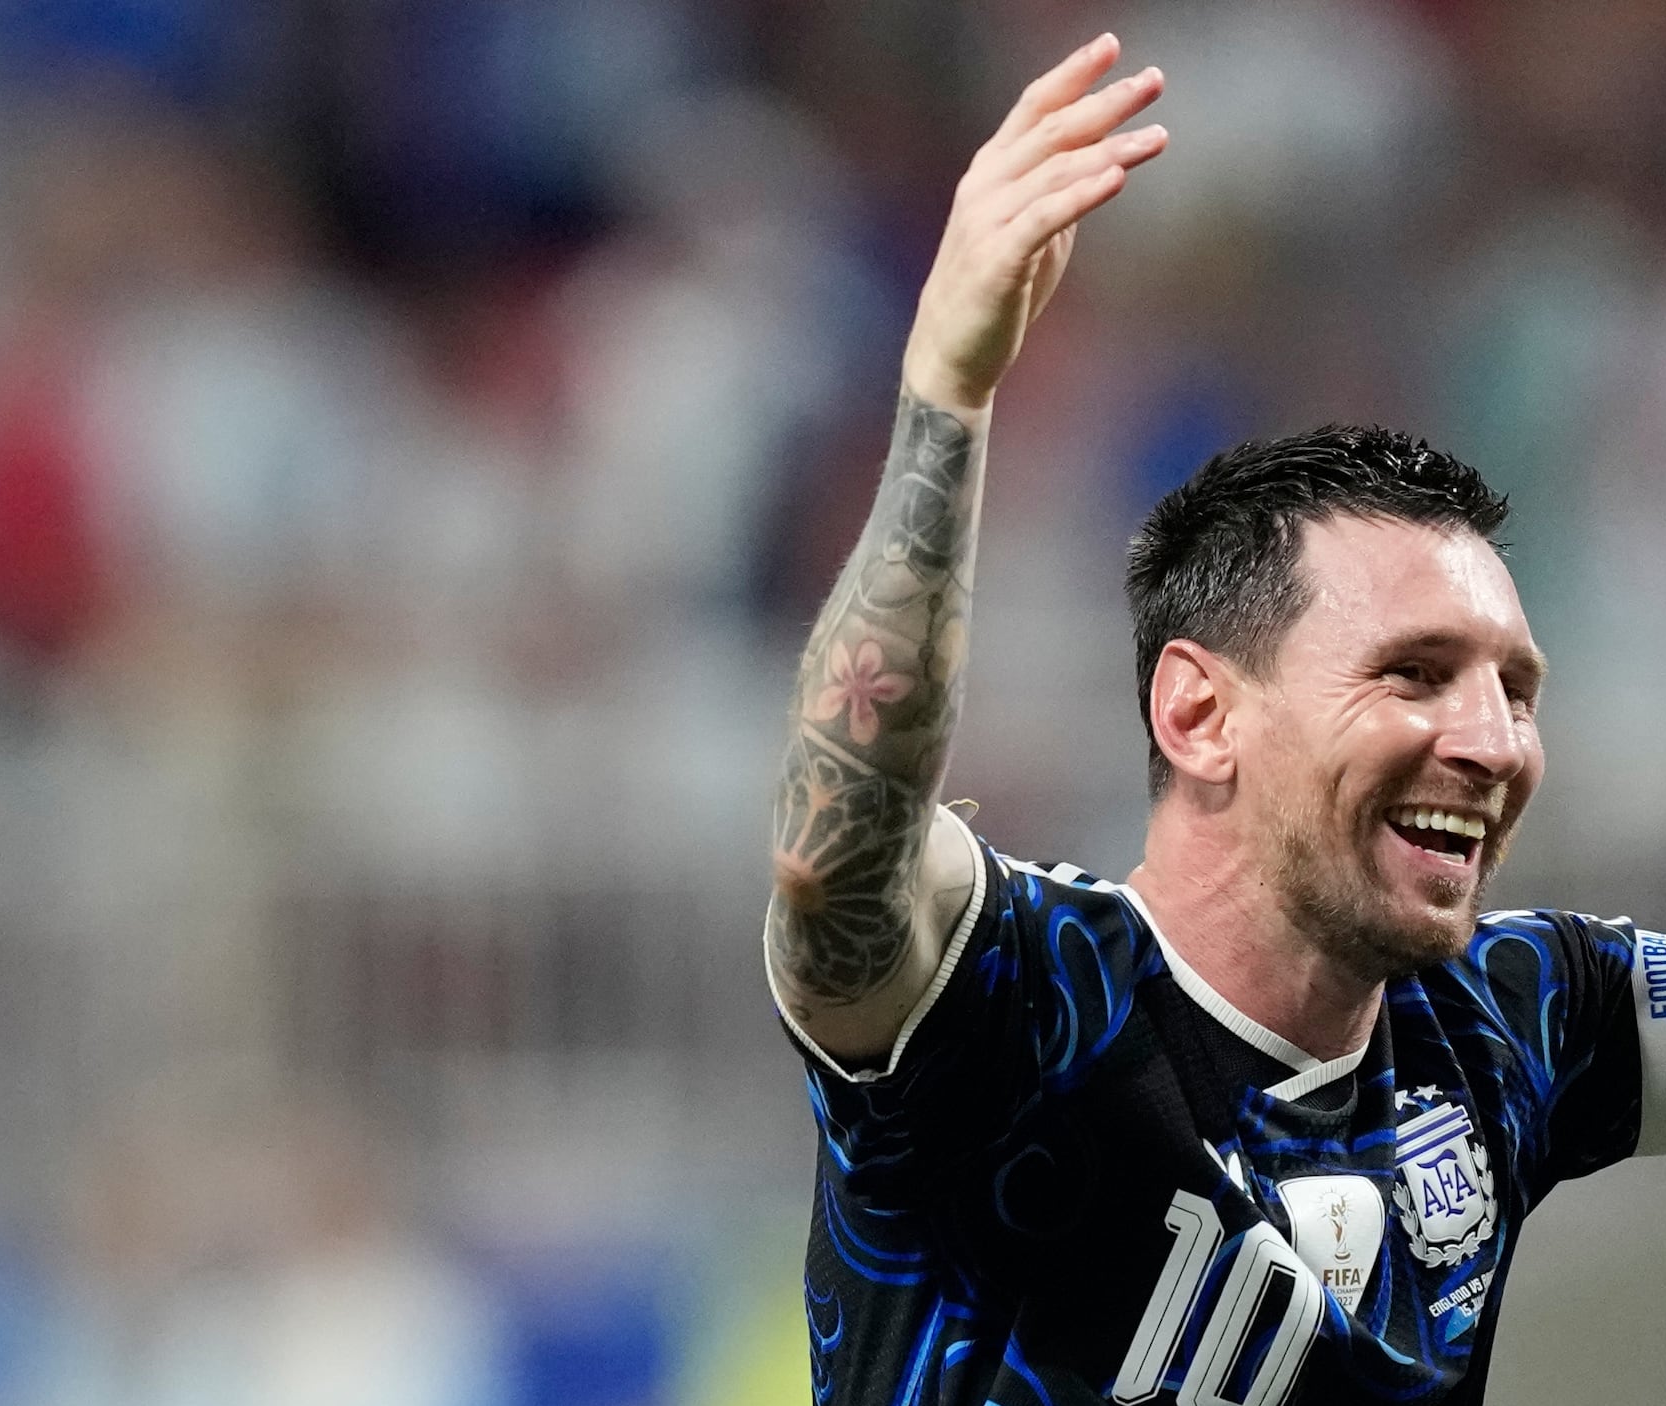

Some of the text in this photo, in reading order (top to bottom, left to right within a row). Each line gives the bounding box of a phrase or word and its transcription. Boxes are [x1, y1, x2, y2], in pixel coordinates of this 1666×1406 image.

[1417, 1148, 1477, 1218] AFA
[1323, 1268, 1361, 1287] FIFA
[1336, 1296, 1354, 1306] 022
[1429, 1285, 1471, 1318] ENGLAND
[1468, 1277, 1483, 1294] VS
[1459, 1302, 1473, 1318] 15
